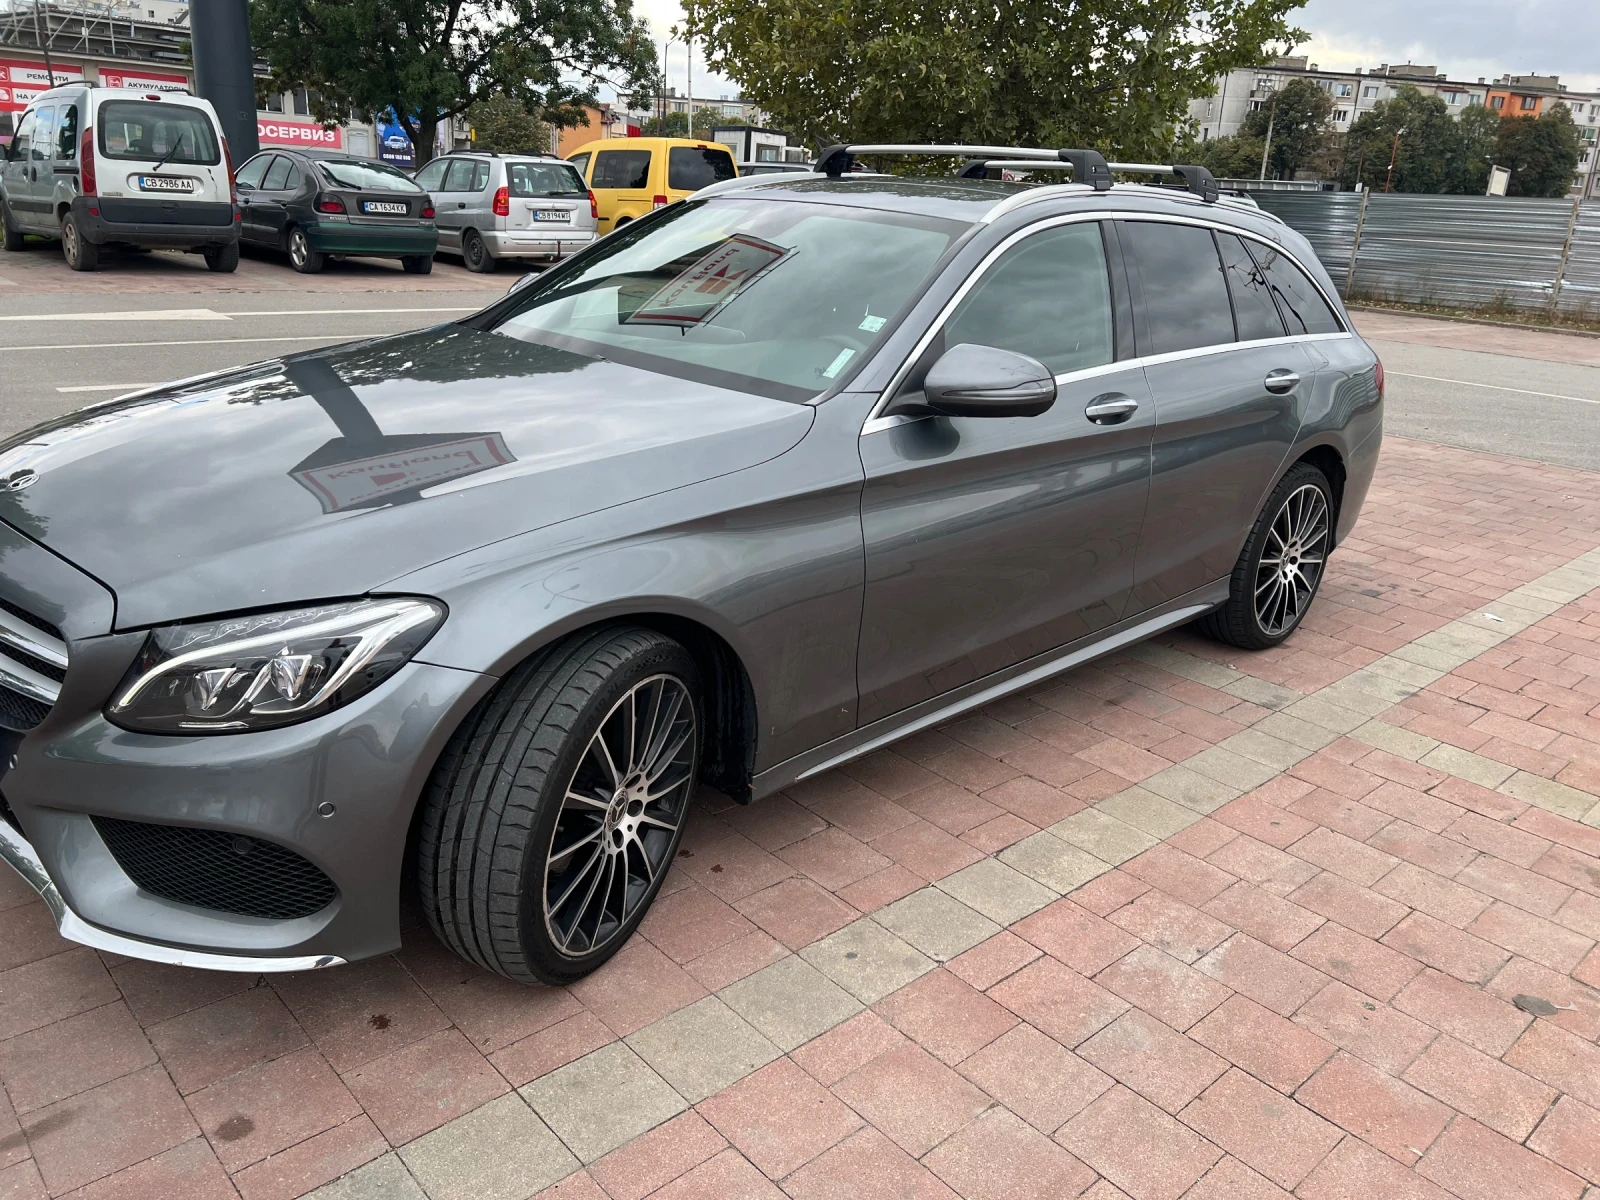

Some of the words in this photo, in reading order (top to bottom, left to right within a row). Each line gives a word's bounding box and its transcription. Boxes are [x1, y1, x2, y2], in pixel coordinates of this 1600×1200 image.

[27, 73, 69, 82] РЕМОНТИ
[158, 179, 180, 188] 2986
[181, 180, 192, 189] AA
